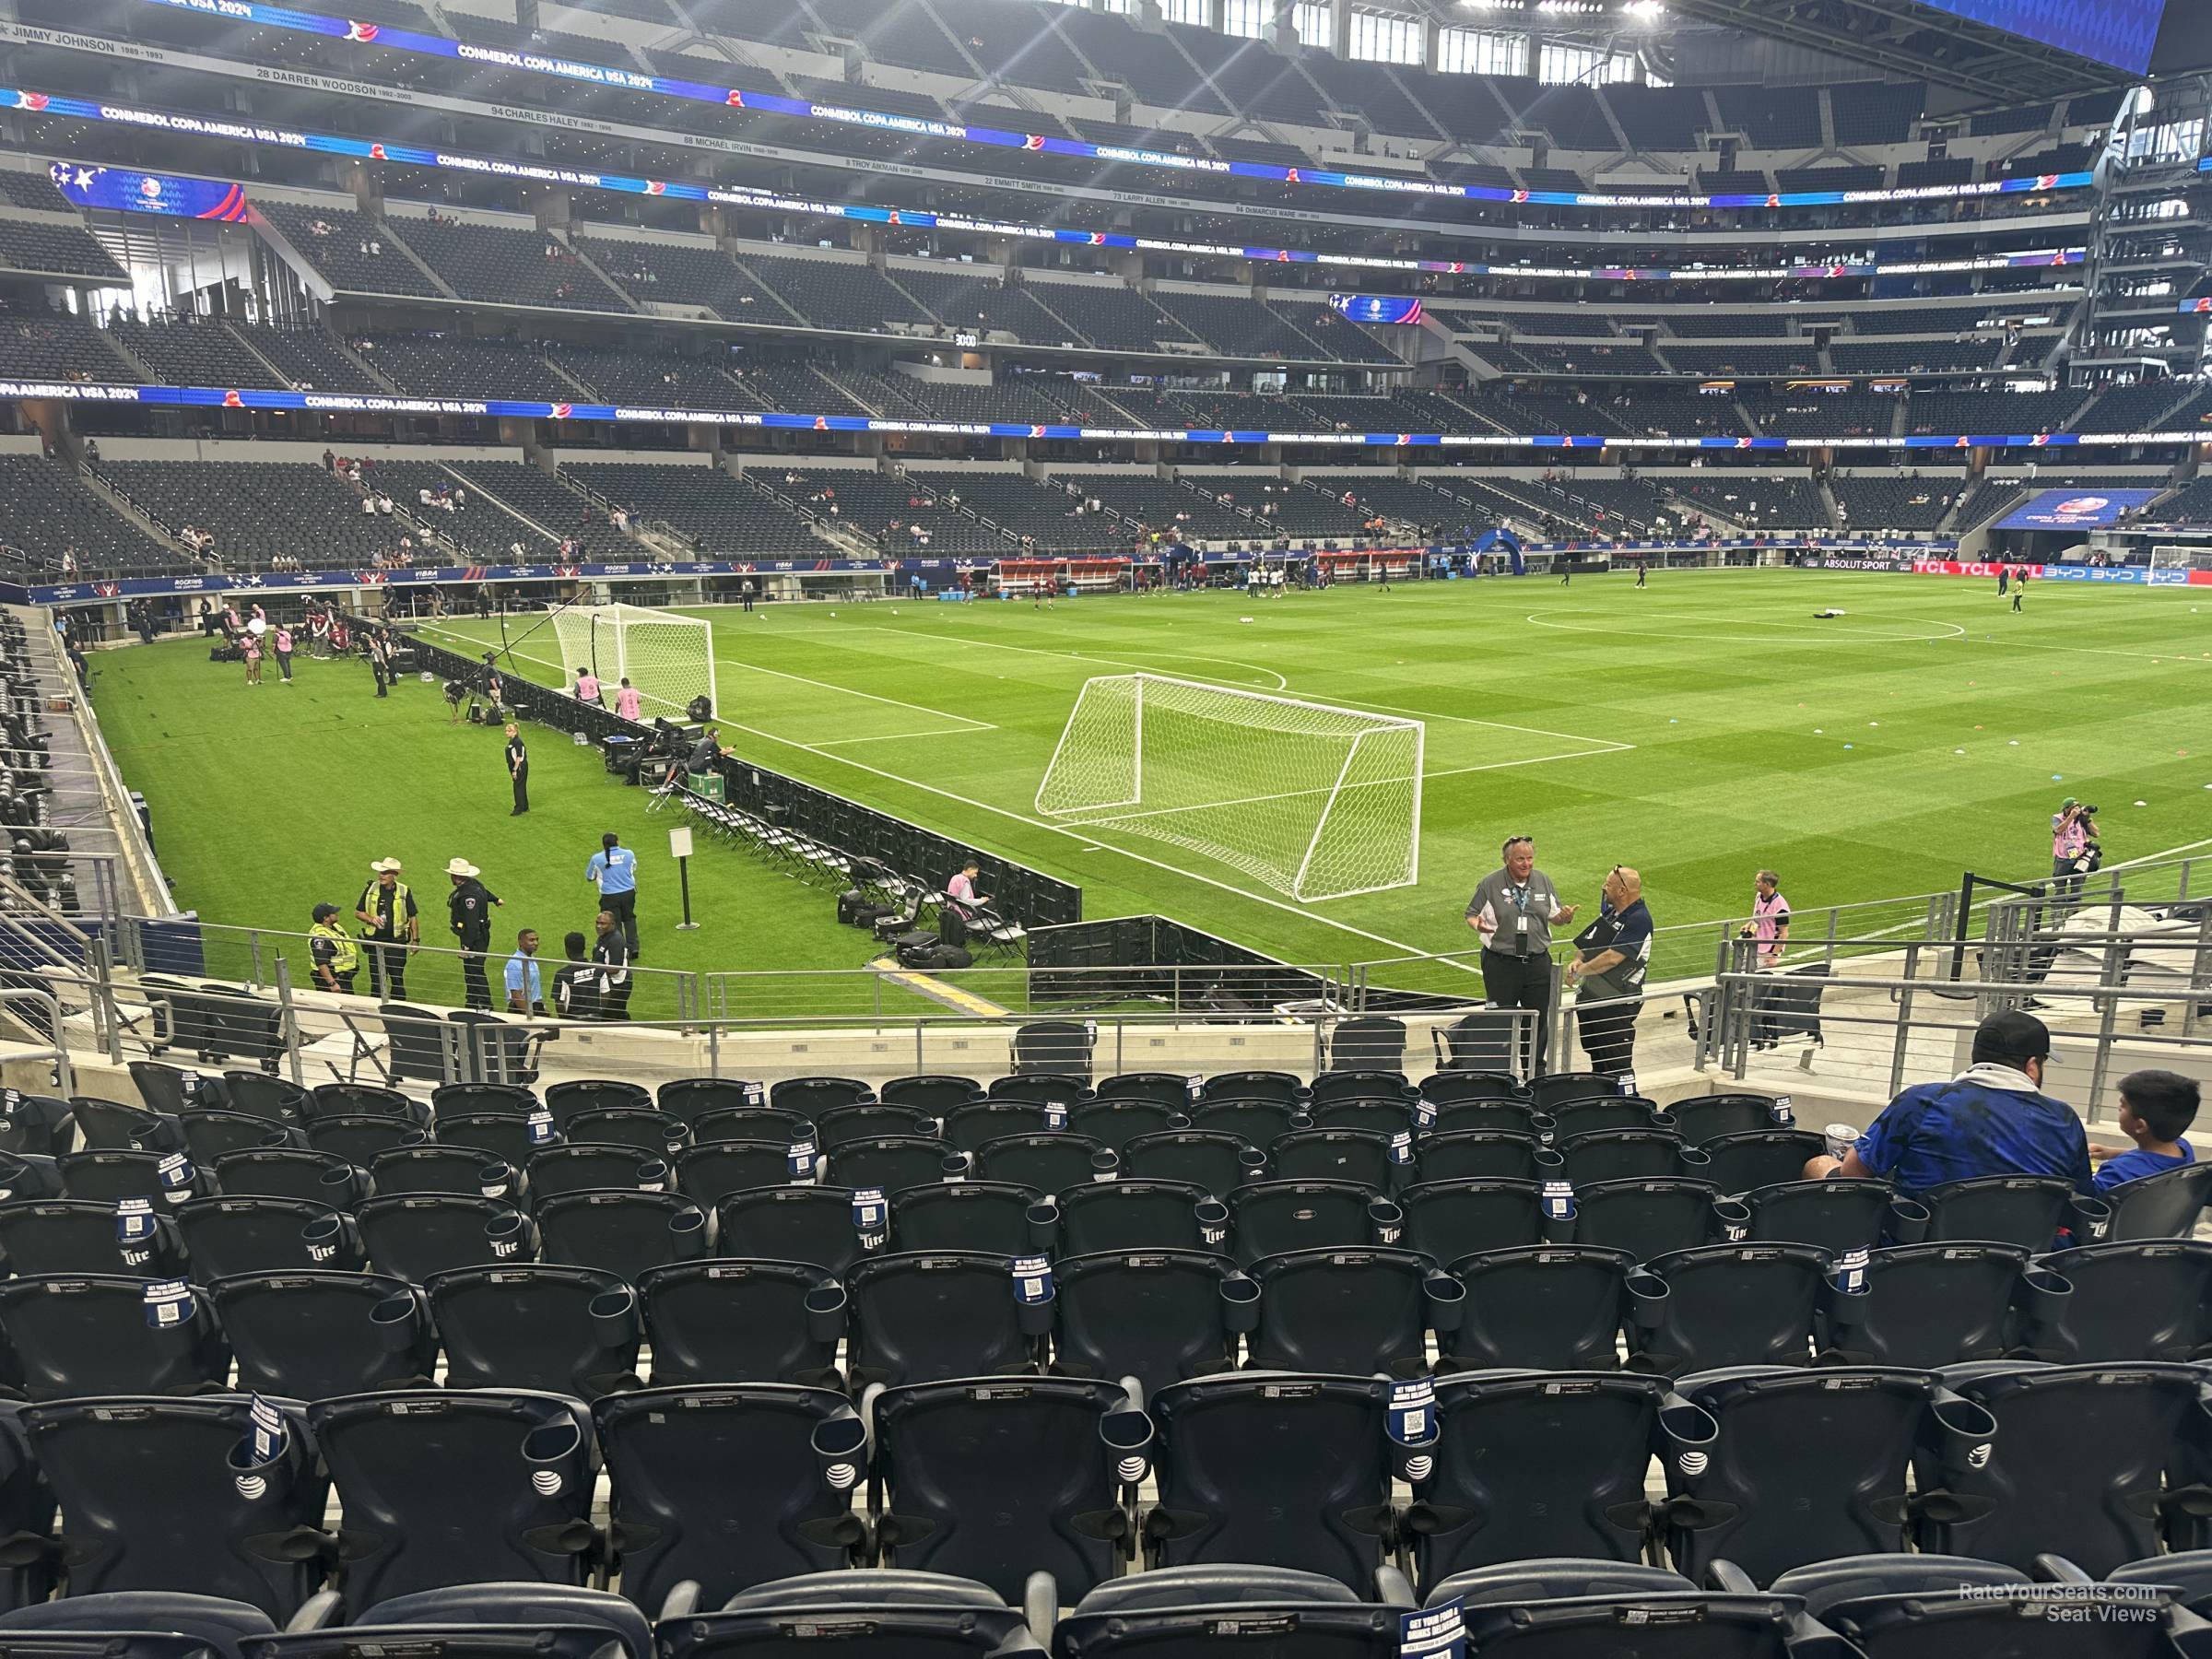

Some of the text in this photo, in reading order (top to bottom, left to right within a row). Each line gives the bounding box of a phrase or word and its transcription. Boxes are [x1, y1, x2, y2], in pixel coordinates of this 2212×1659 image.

[219, 0, 252, 17] 2024
[13, 27, 51, 41] JIMMY
[55, 34, 114, 53] JOHNSON
[121, 46, 138, 54] 1989
[147, 51, 163, 60] 1993
[458, 45, 653, 88] CONMEBOL COPA AMERICA USA 2024
[257, 68, 269, 78] 28
[273, 72, 318, 87] DARREN
[322, 79, 376, 96] WOODSON
[491, 106, 503, 116] 94
[505, 108, 548, 123] CHARLES
[549, 116, 578, 126] HALEY
[811, 106, 966, 137] CONMEBOL COPA AMERICA USA 2024
[100, 107, 306, 145] CONMEBOL COPA AMERICA USA 2024
[695, 137, 730, 149] MICHAEL
[732, 143, 752, 153] IRVIN
[852, 160, 871, 170] TROY
[872, 163, 899, 173] AIKMAN
[1097, 147, 1140, 161] CONMEBOL
[1141, 153, 1161, 163] COPA
[1162, 156, 1195, 168] AMERICA
[1197, 159, 1210, 170] USA
[437, 155, 600, 184] CONMEBOL COPA AMERICA USA 2024
[984, 177, 993, 185] 22
[994, 178, 1020, 188] EMMITT
[1021, 182, 1041, 191] SMITH
[1345, 177, 1382, 188] CONMEBOL
[1384, 181, 1402, 190] COPA
[1402, 182, 1433, 193] AMERICA
[708, 190, 752, 205] CONMEBOL
[753, 197, 775, 206] COPA
[775, 200, 809, 211] AMERICA
[811, 204, 825, 213] USA
[1123, 194, 1144, 203] LARRY
[1145, 196, 1165, 205] ALLEN
[1576, 195, 1617, 205] CONMEBOL
[1843, 191, 1891, 202] CONMEBOL
[1893, 189, 1917, 198] COPA
[1917, 186, 1958, 196] AMERICA
[1279, 209, 1296, 218] WARE
[935, 218, 975, 229] CONMEBOL
[975, 223, 994, 231] COPA
[994, 225, 1025, 235] AMERICA
[955, 334, 976, 347] 30:00
[19, 385, 80, 397] AMERICA
[82, 387, 107, 398] USA
[108, 388, 138, 399] 2024
[305, 396, 487, 412] CONMEBOL COPA AMERICA USA 2024
[616, 409, 664, 419] CONMEBOL
[665, 412, 688, 420] COPA
[688, 413, 724, 422] AMERICA
[1824, 559, 1862, 570] ABSOLUT
[1863, 560, 1890, 571] SPORT
[1915, 561, 1949, 573] TCL
[1959, 562, 1994, 575] TCL
[2044, 568, 2086, 578] BYD
[2091, 569, 2134, 580] BYD
[573, 968, 596, 977] BEST
[492, 1241, 518, 1257] Lite
[861, 1234, 885, 1250] Lite
[123, 1250, 149, 1266] Lite
[309, 1245, 336, 1261] Lite
